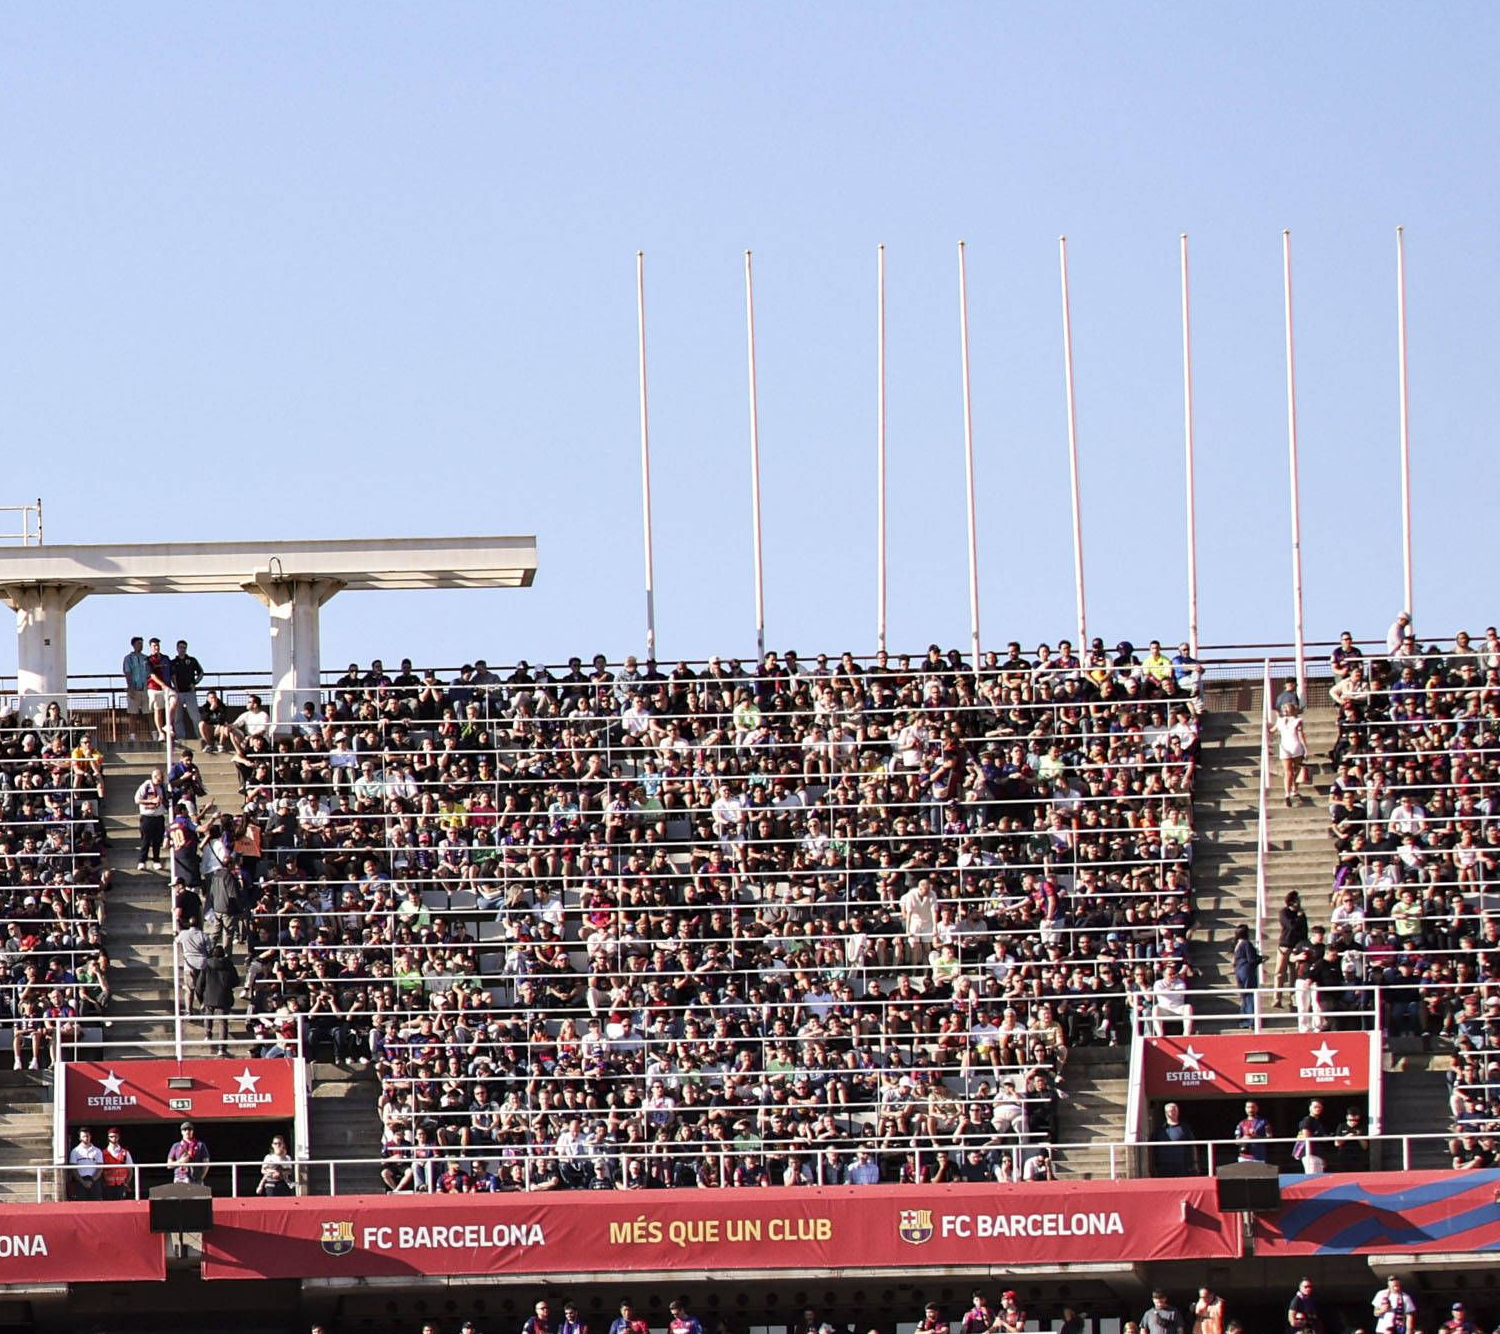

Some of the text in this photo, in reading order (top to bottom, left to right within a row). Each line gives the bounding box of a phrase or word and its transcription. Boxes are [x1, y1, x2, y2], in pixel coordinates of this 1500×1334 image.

[1166, 1071, 1216, 1081] ESTRELLA
[1300, 1067, 1350, 1077] ESTRELLA
[87, 1096, 137, 1106] ESTRELLA
[222, 1094, 272, 1103] ESTRELLA
[941, 1212, 1124, 1237] FC BARCELONA
[609, 1215, 833, 1246] MÉS QUE UN CLUB
[363, 1224, 545, 1249] FC BARCELONA
